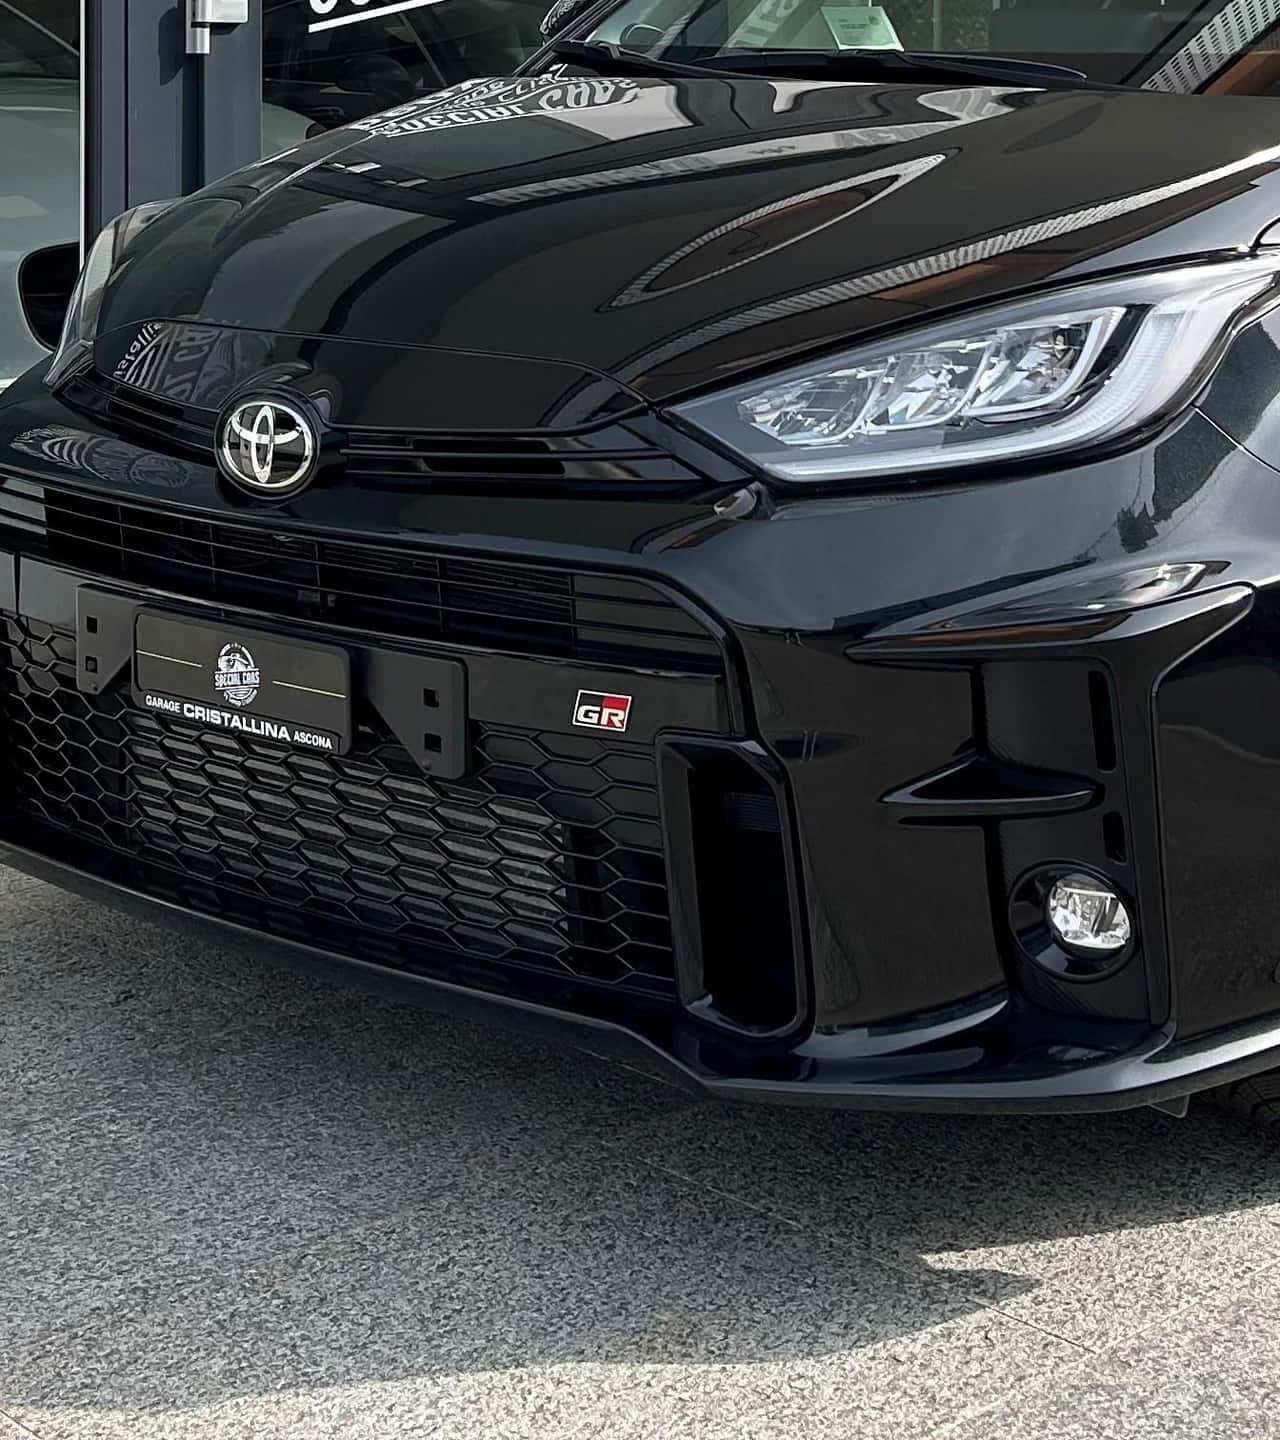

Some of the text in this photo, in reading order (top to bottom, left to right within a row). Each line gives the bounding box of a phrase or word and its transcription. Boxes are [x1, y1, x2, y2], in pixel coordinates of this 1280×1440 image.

[145, 694, 333, 750] GARAGE CRISTALLINA ASCONA
[577, 704, 625, 728] GR
